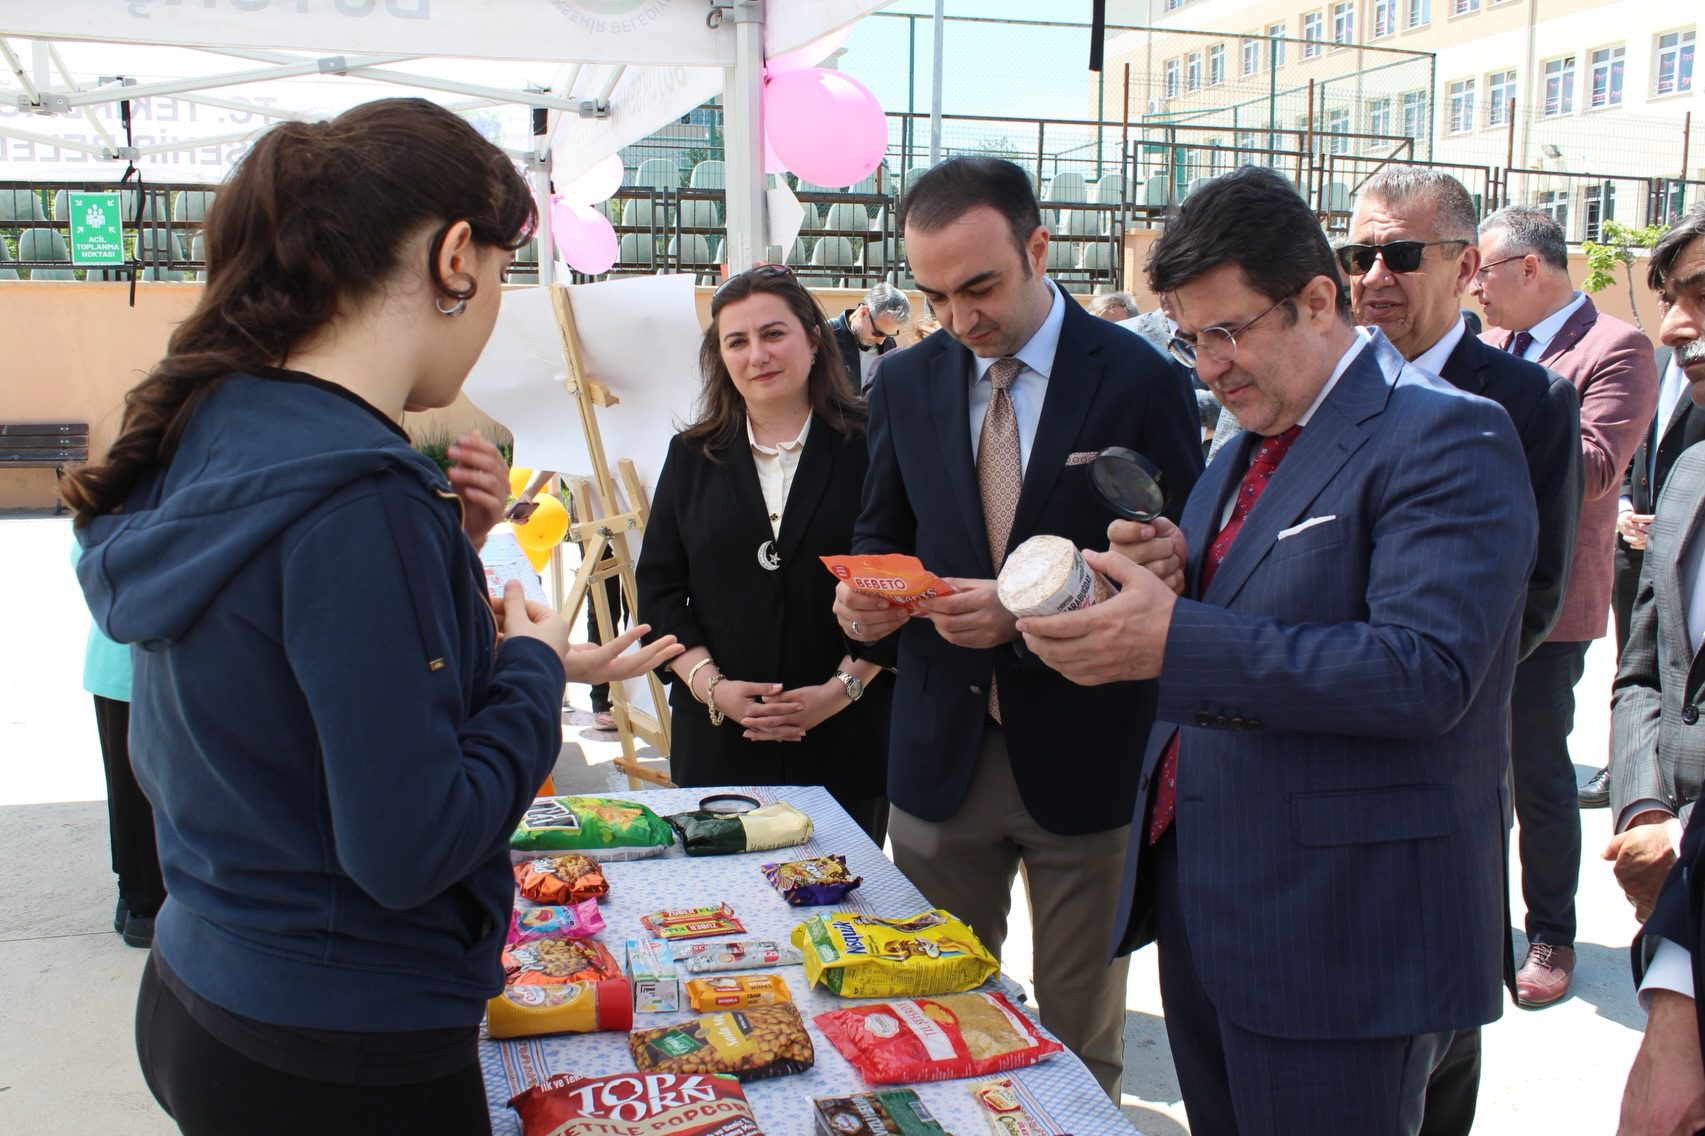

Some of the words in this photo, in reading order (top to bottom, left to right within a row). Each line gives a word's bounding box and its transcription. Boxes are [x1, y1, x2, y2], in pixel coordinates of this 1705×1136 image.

[88, 235, 107, 243] ACİL
[854, 578, 906, 590] BEBETO
[1063, 573, 1092, 612] ARABUĞDAY
[556, 1122, 645, 1136] ETTLE
